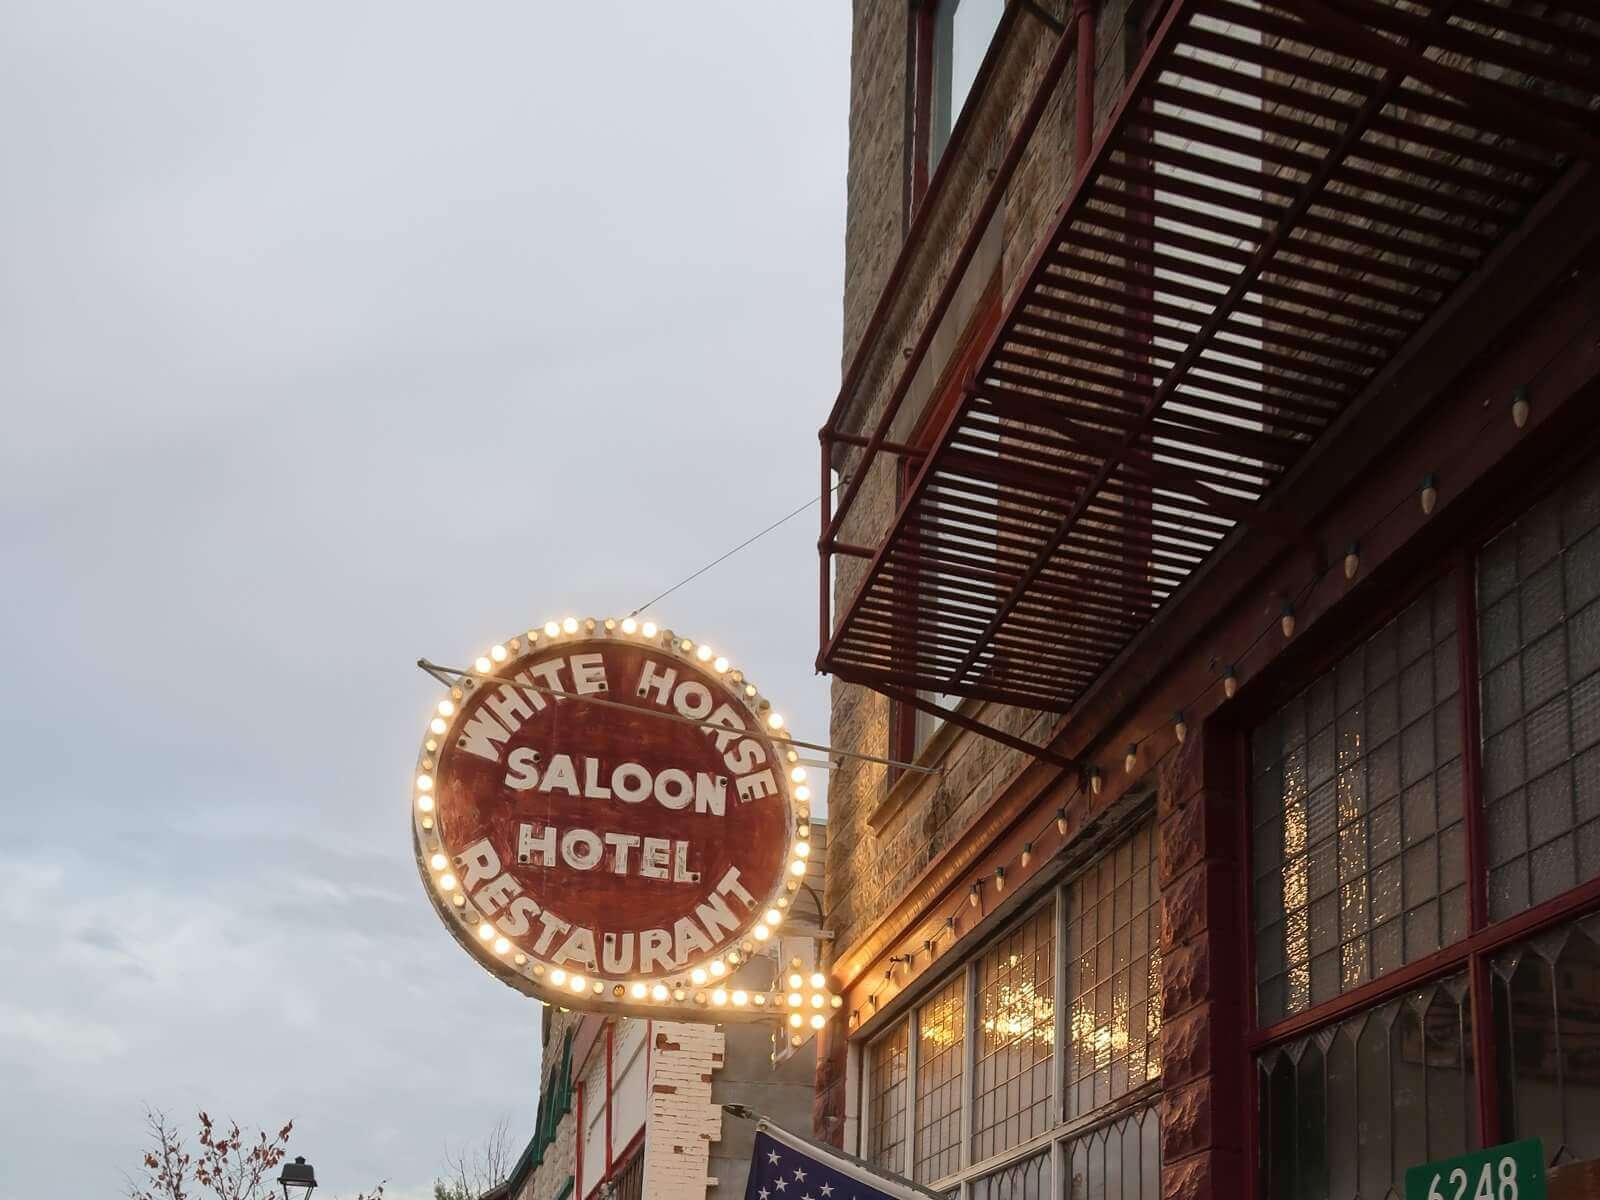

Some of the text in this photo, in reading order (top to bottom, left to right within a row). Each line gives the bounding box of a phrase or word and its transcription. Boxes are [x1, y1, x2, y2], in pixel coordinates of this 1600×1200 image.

[456, 654, 779, 804] WHITE HORSE
[504, 747, 728, 817] SALOON
[517, 823, 701, 884] HOTEL
[453, 837, 758, 974] RESTAURANT
